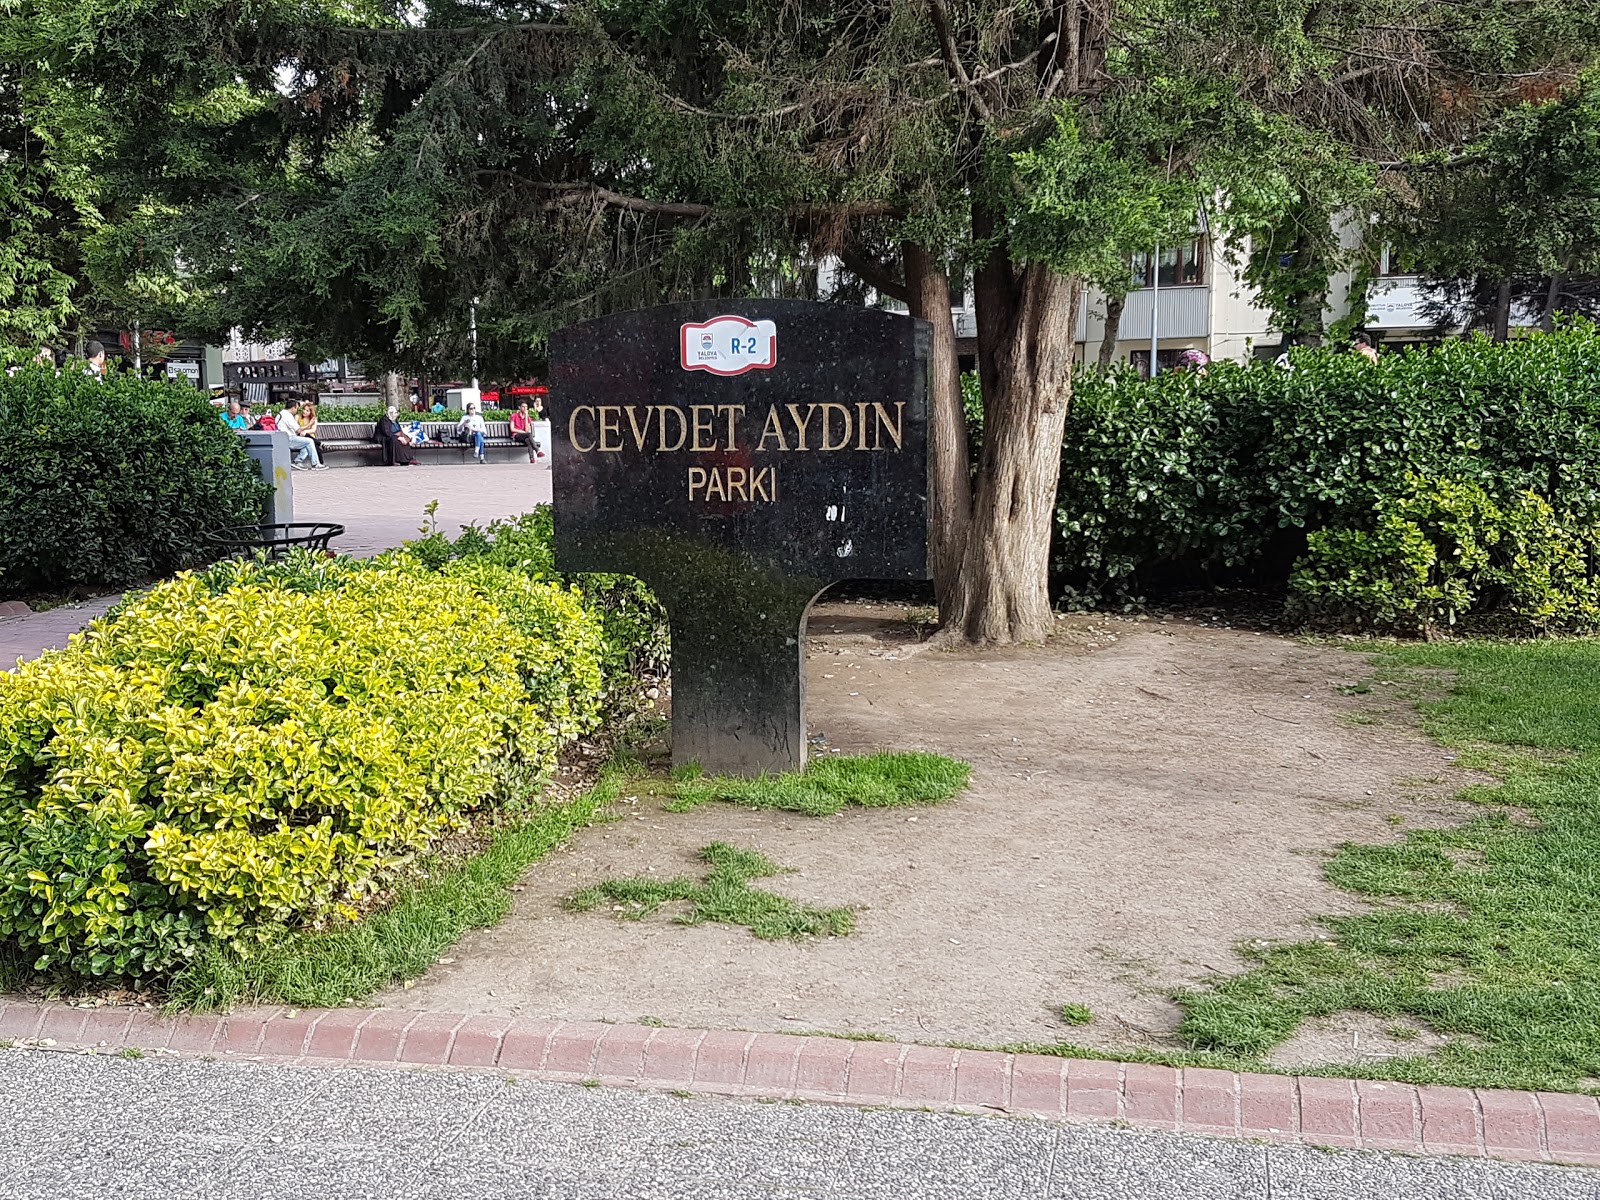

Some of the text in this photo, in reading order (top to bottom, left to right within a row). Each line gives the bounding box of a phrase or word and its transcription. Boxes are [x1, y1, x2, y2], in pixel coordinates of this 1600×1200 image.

[731, 337, 756, 354] R-2
[568, 401, 906, 453] CEVDET AYDIN
[688, 467, 776, 502] PARKI
